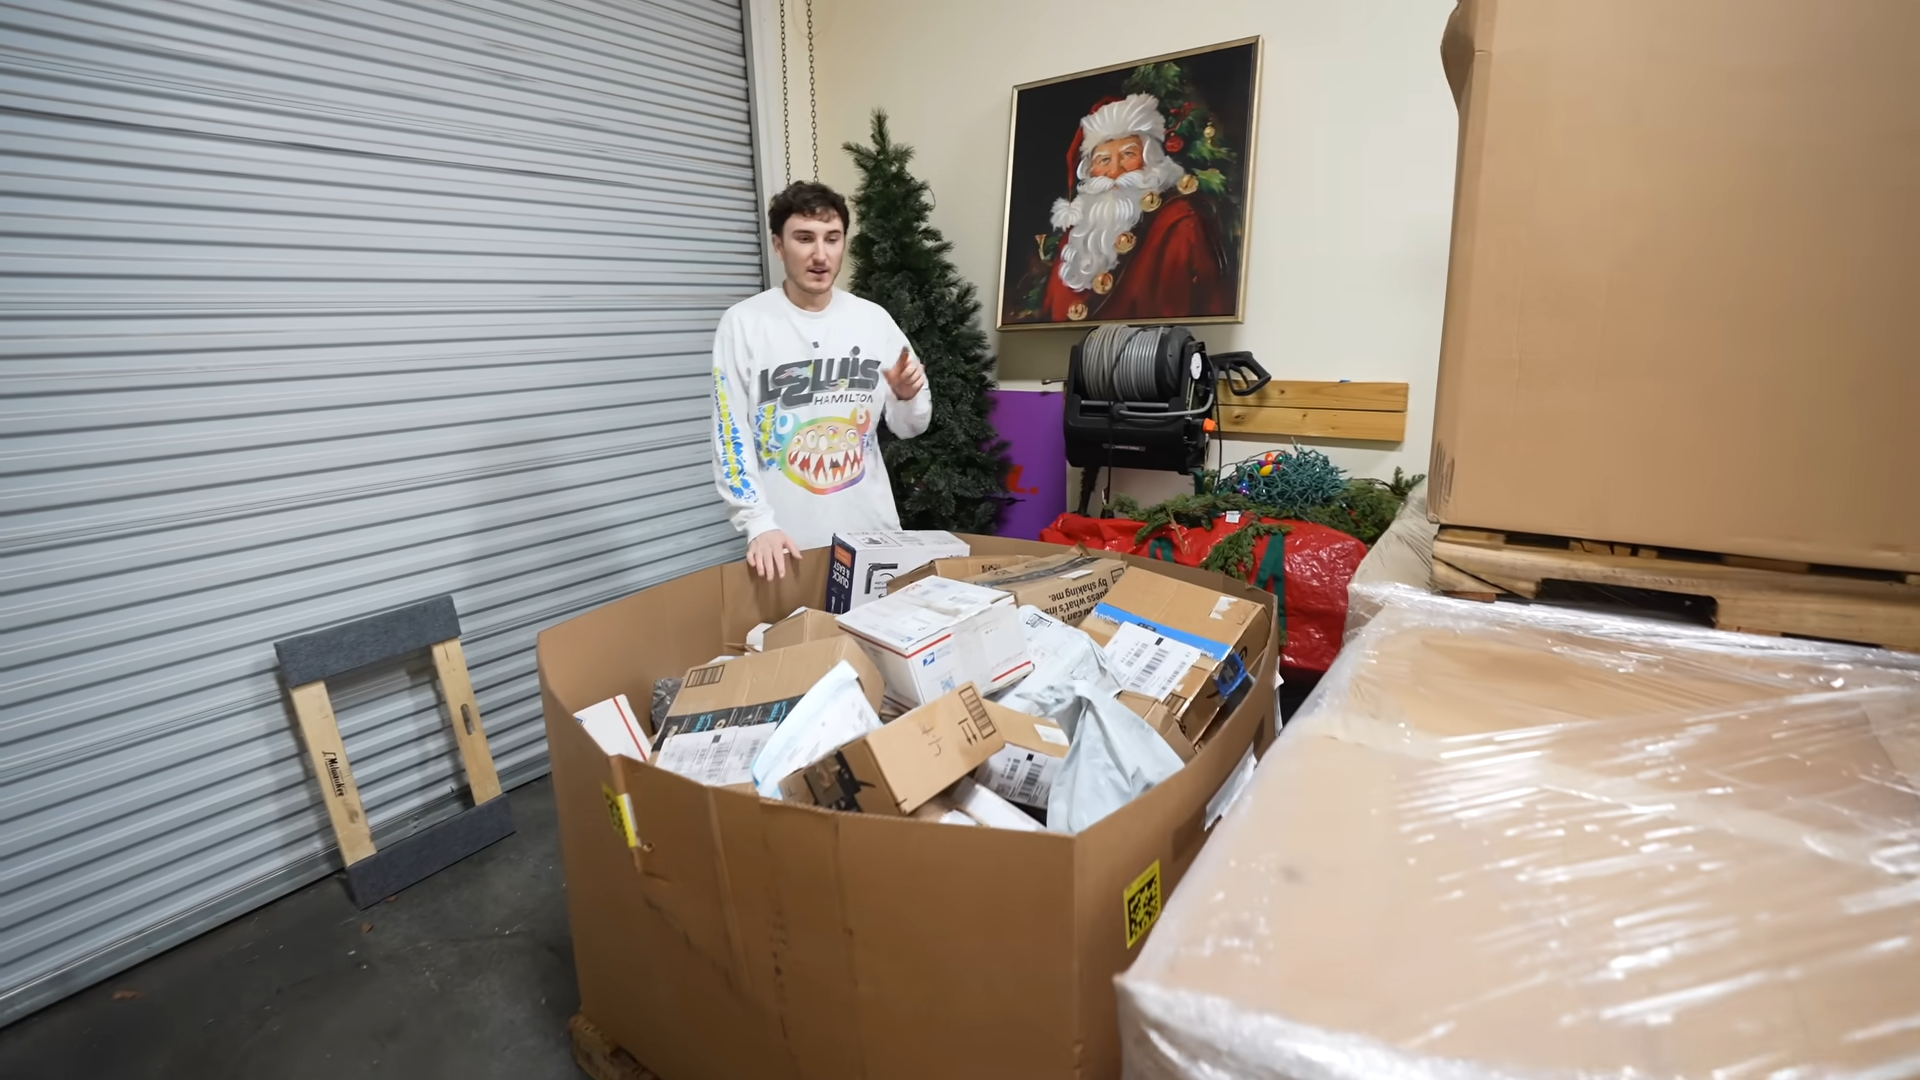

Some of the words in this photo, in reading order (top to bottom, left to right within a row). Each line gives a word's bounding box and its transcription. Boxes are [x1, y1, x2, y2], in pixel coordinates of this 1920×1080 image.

[833, 561, 846, 576] EASY
[832, 569, 850, 589] QUICK
[1098, 578, 1108, 587] by
[1048, 593, 1065, 602] me.
[1065, 581, 1097, 598] shaking
[1059, 596, 1087, 613] what's
[1061, 611, 1083, 624] can't
[328, 757, 345, 797] Milwaukee
